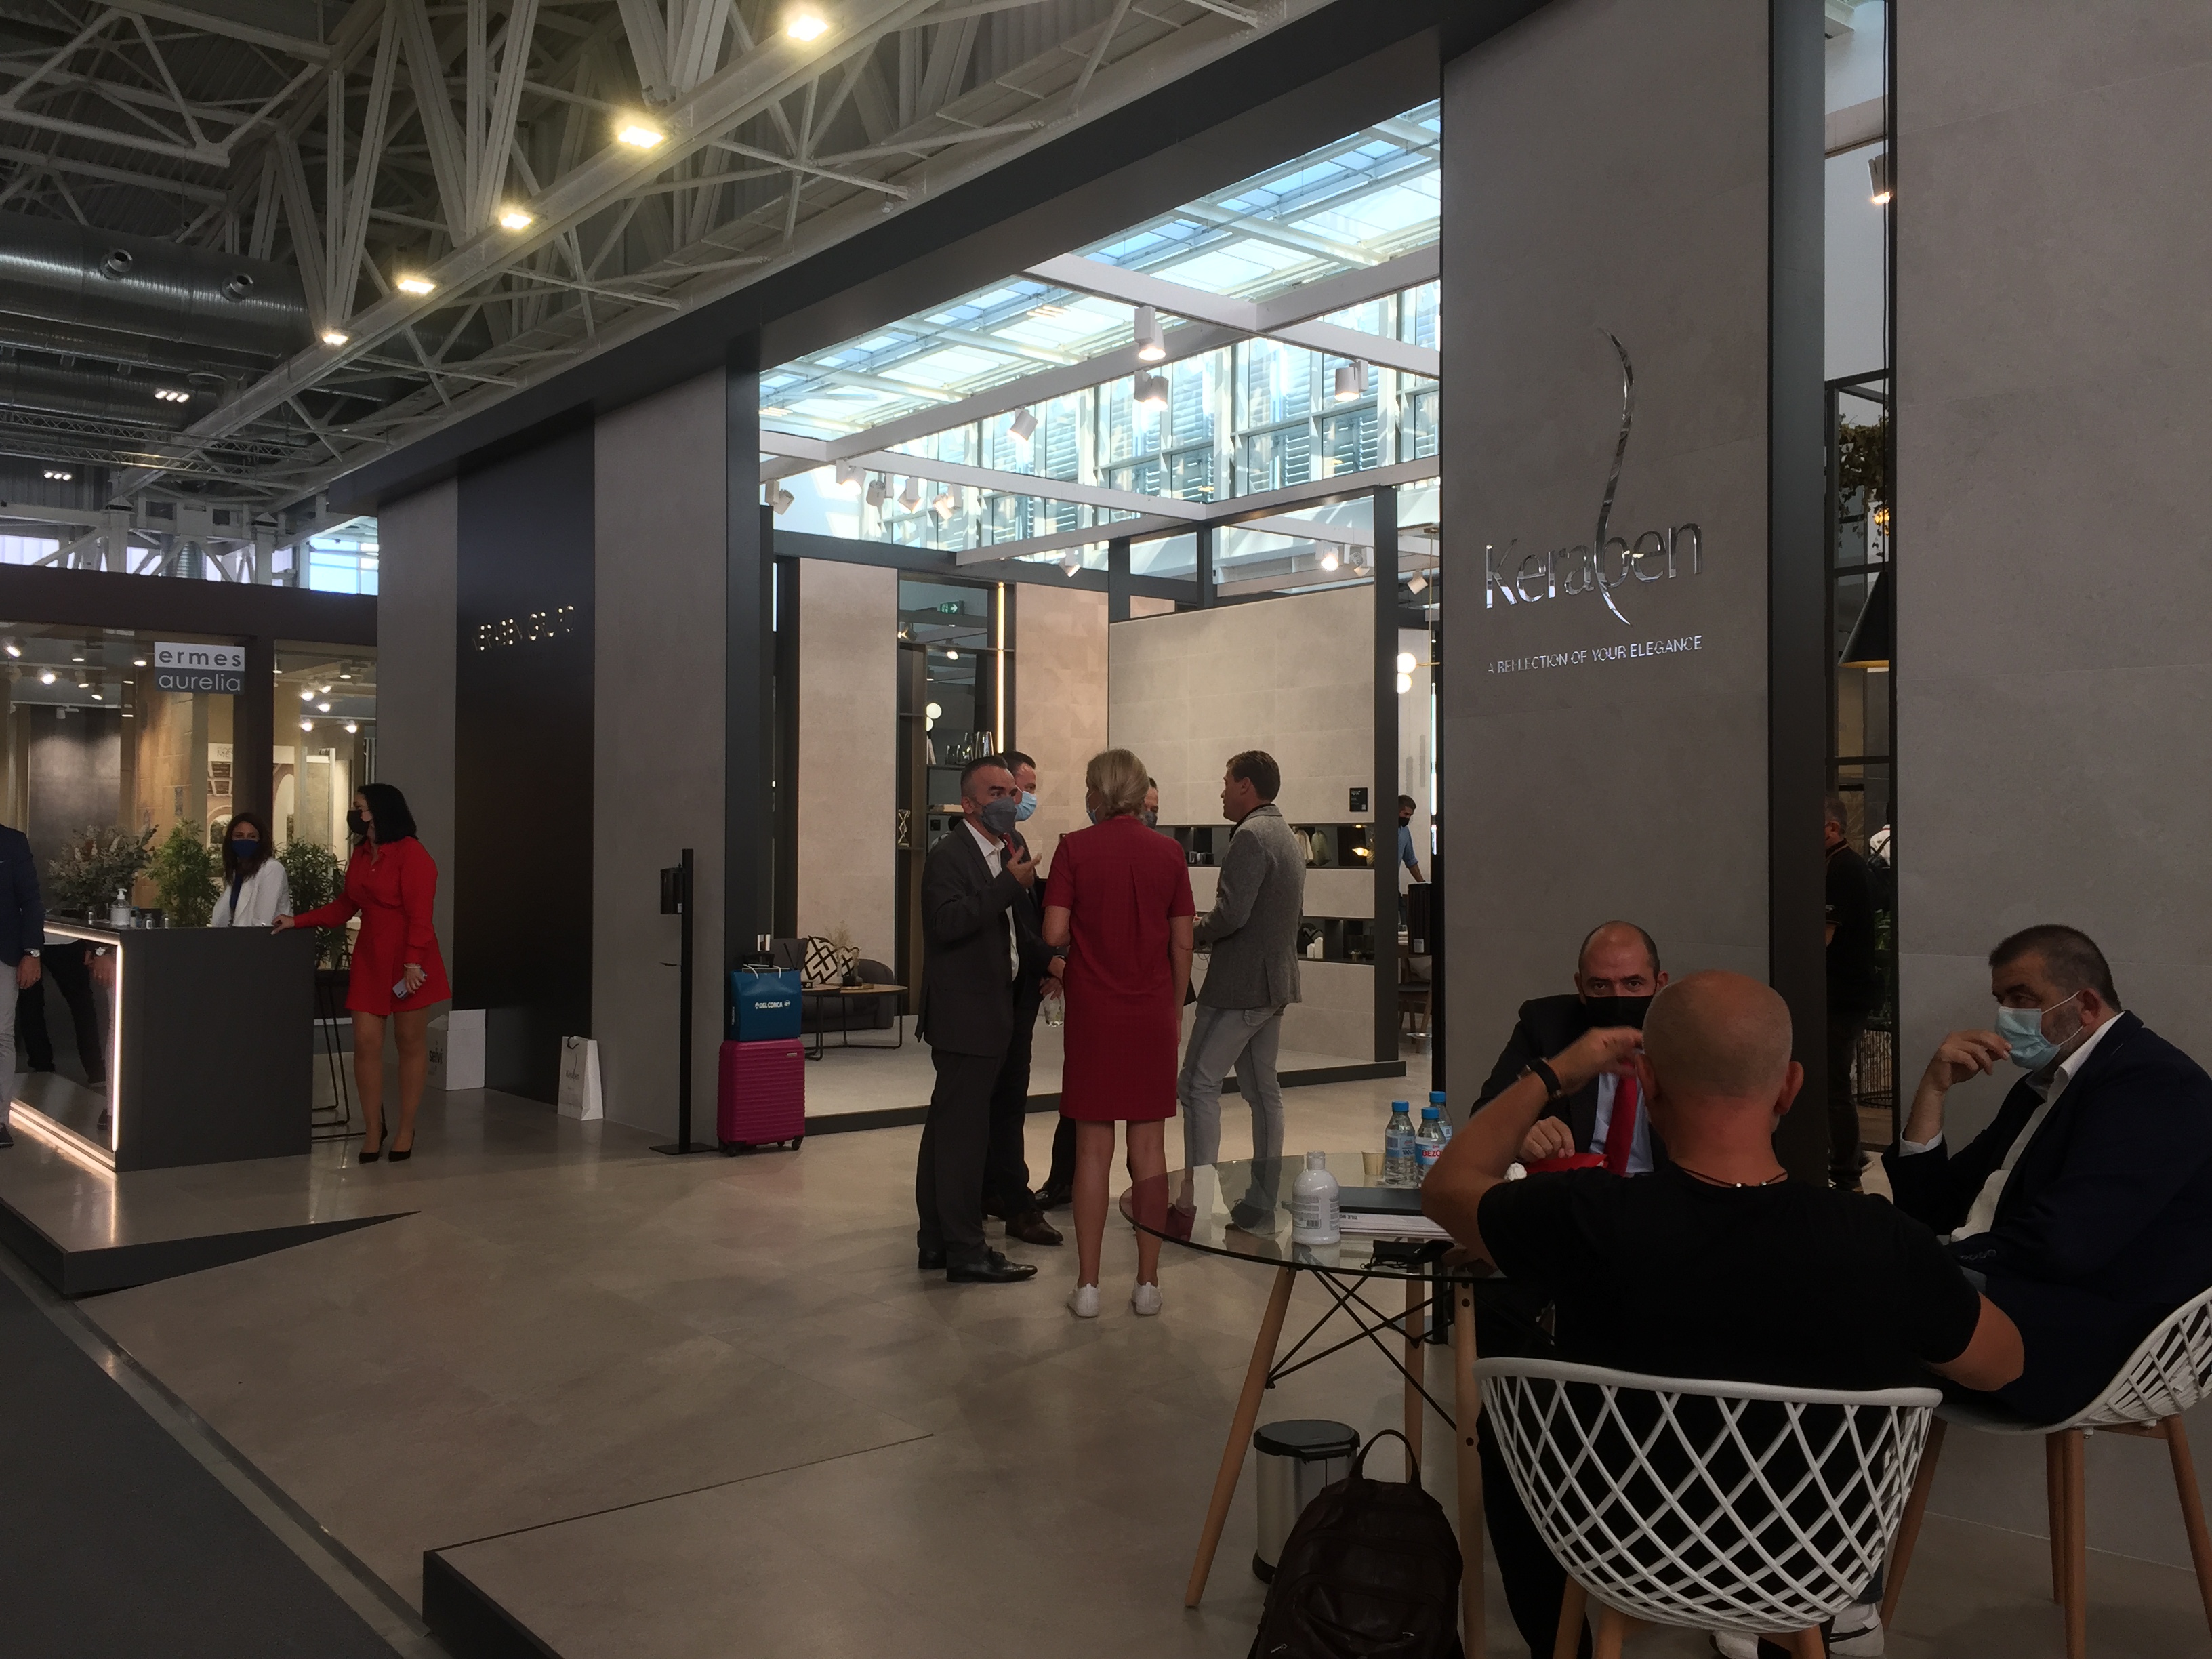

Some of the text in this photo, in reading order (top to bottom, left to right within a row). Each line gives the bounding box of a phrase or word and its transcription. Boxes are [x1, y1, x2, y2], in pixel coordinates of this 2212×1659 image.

[159, 651, 241, 667] ermes
[1488, 634, 1703, 674] A REFLECTION OF YOUR ELEGANCE
[159, 674, 241, 691] aurelia
[1422, 1149, 1442, 1158] BEZO
